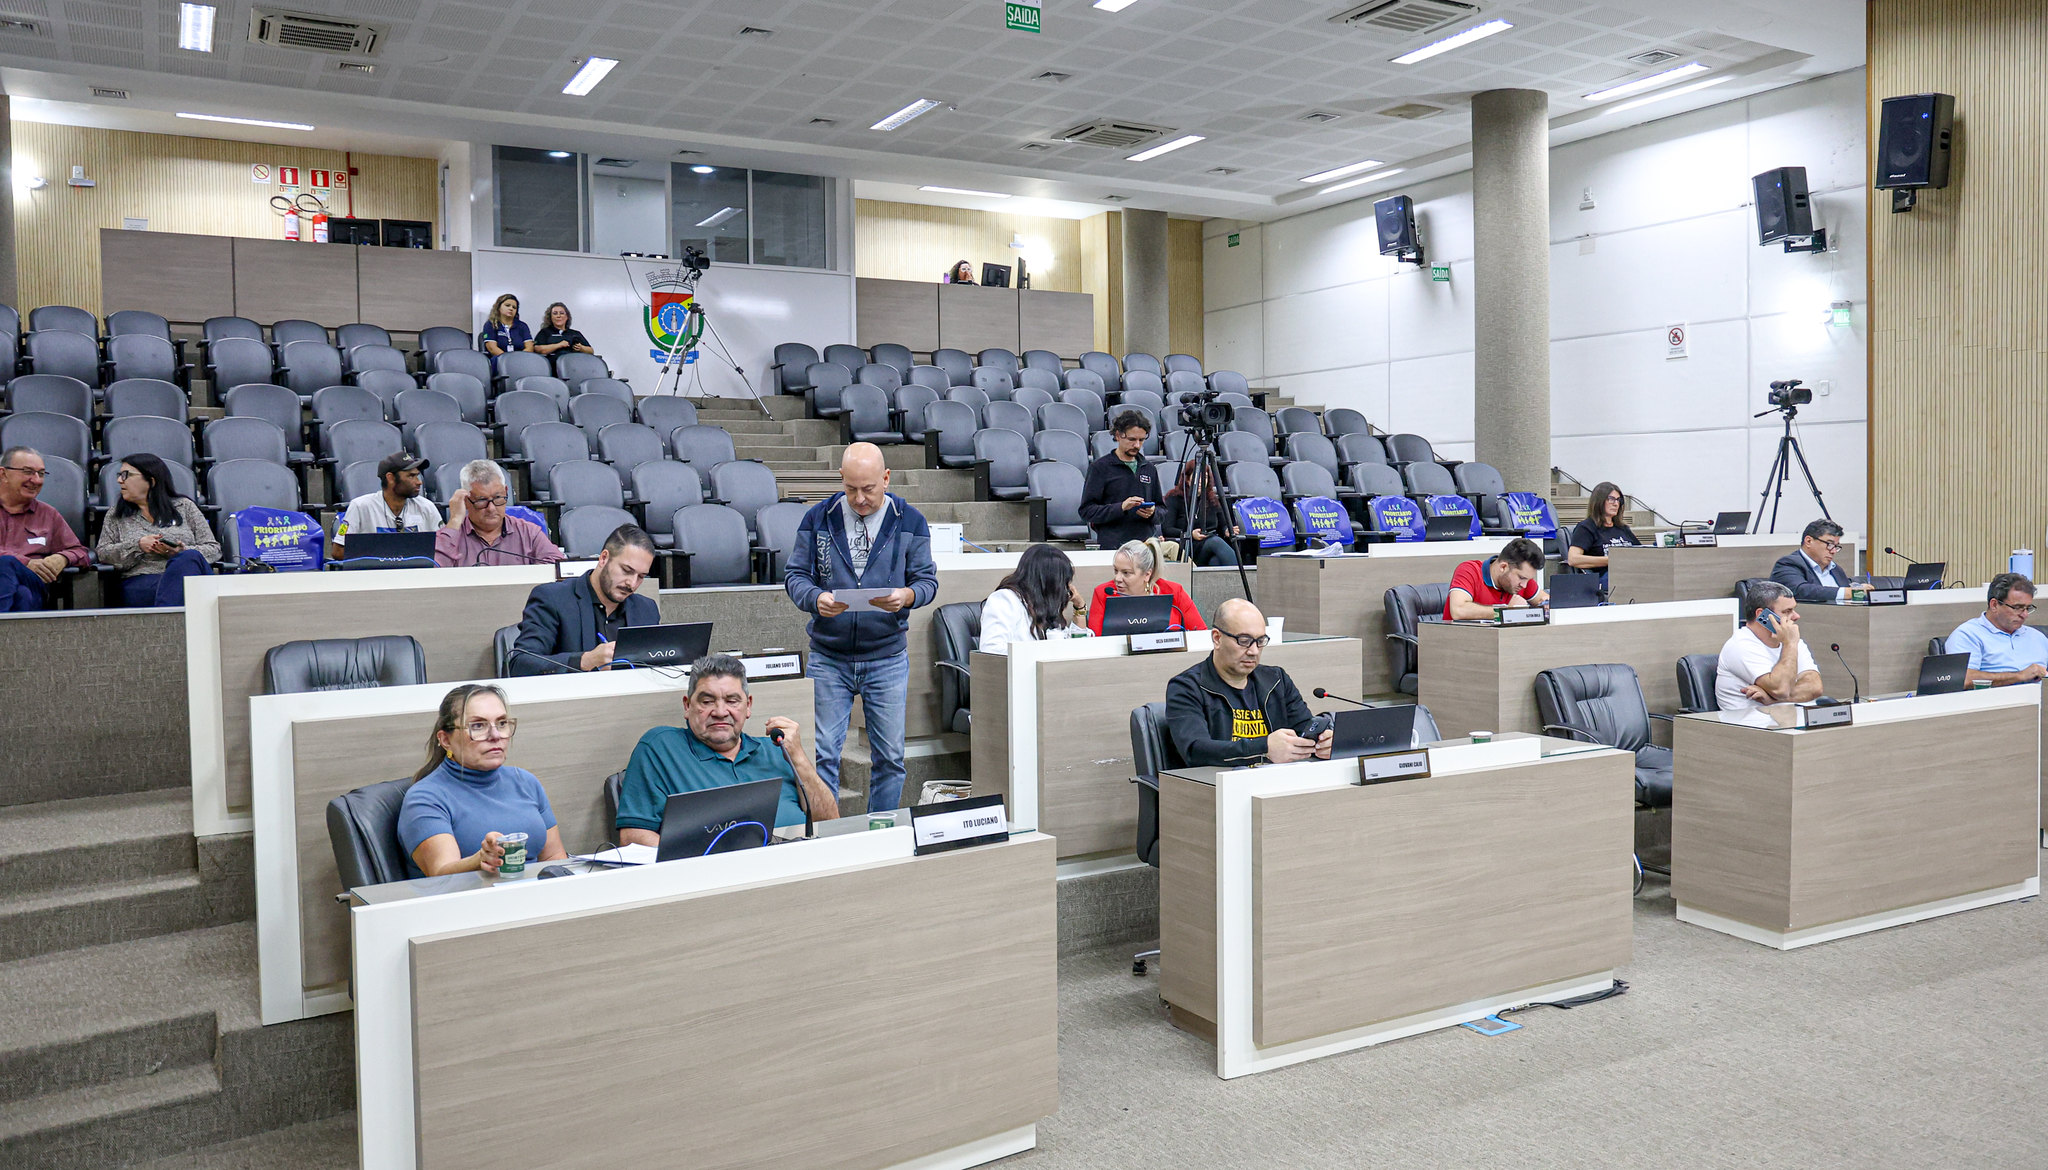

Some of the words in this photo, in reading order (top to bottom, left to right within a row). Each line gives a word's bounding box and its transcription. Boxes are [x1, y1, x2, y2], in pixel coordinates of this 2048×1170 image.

[817, 533, 827, 561] LAST
[1127, 617, 1148, 625] VAIO
[648, 649, 676, 658] VAIO
[1936, 674, 1951, 682] VAIO
[963, 820, 973, 829] ITO
[974, 815, 998, 828] LUCIANO
